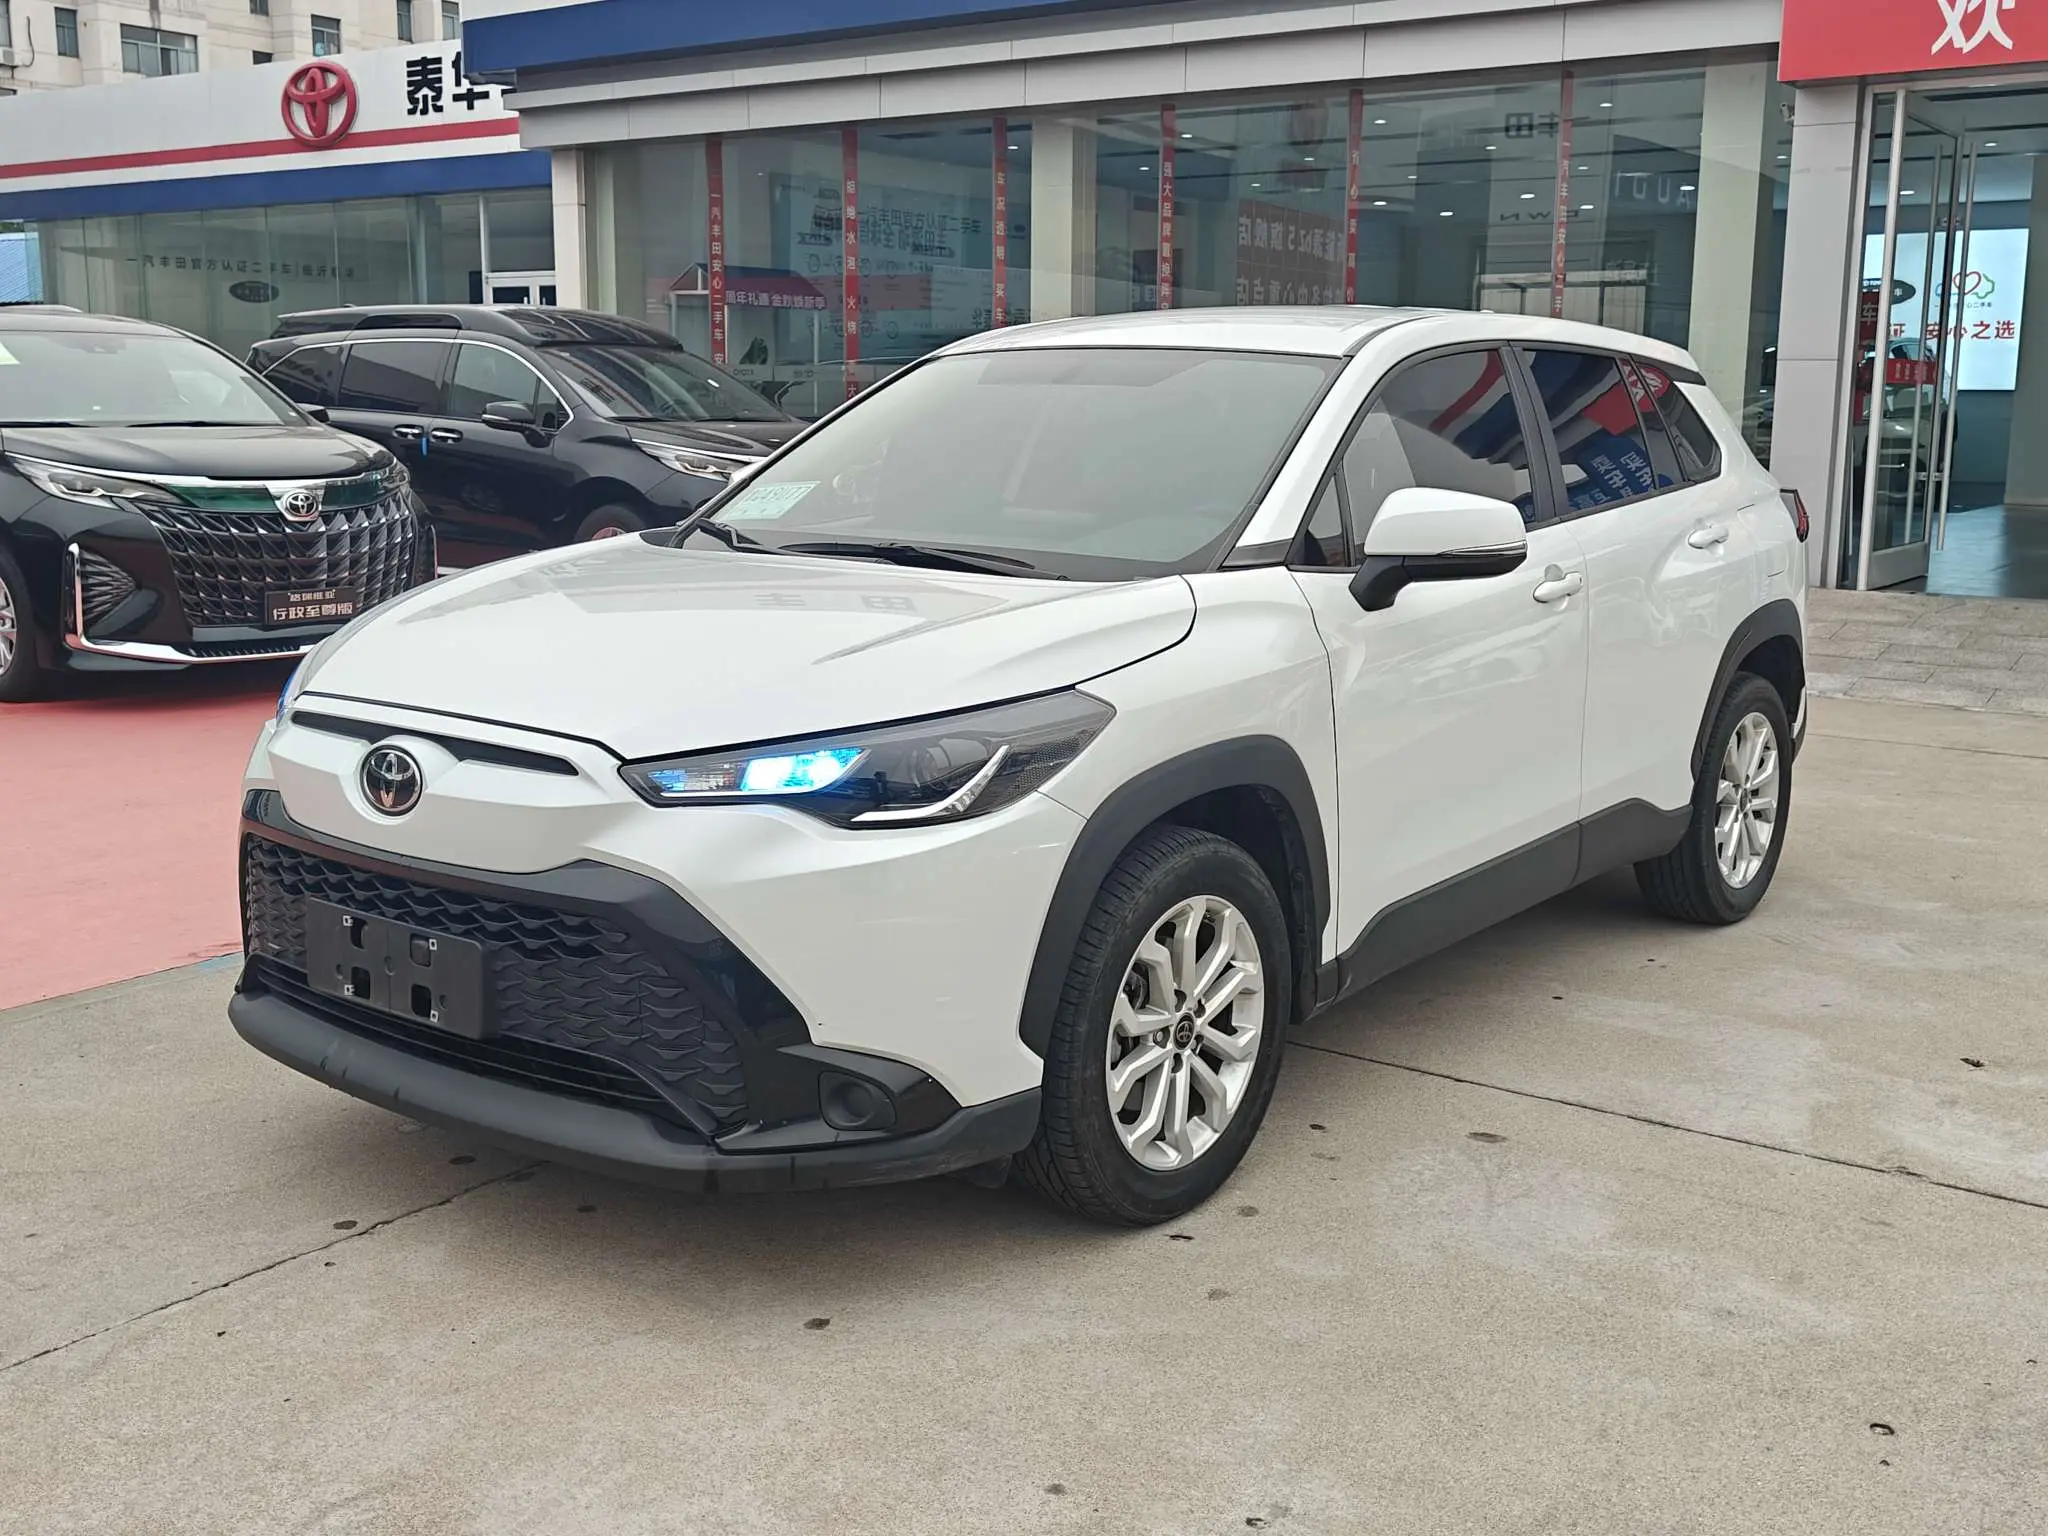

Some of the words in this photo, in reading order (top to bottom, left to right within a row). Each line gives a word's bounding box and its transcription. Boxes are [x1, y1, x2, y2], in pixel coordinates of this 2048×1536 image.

[272, 602, 353, 621] 行政至尊版
